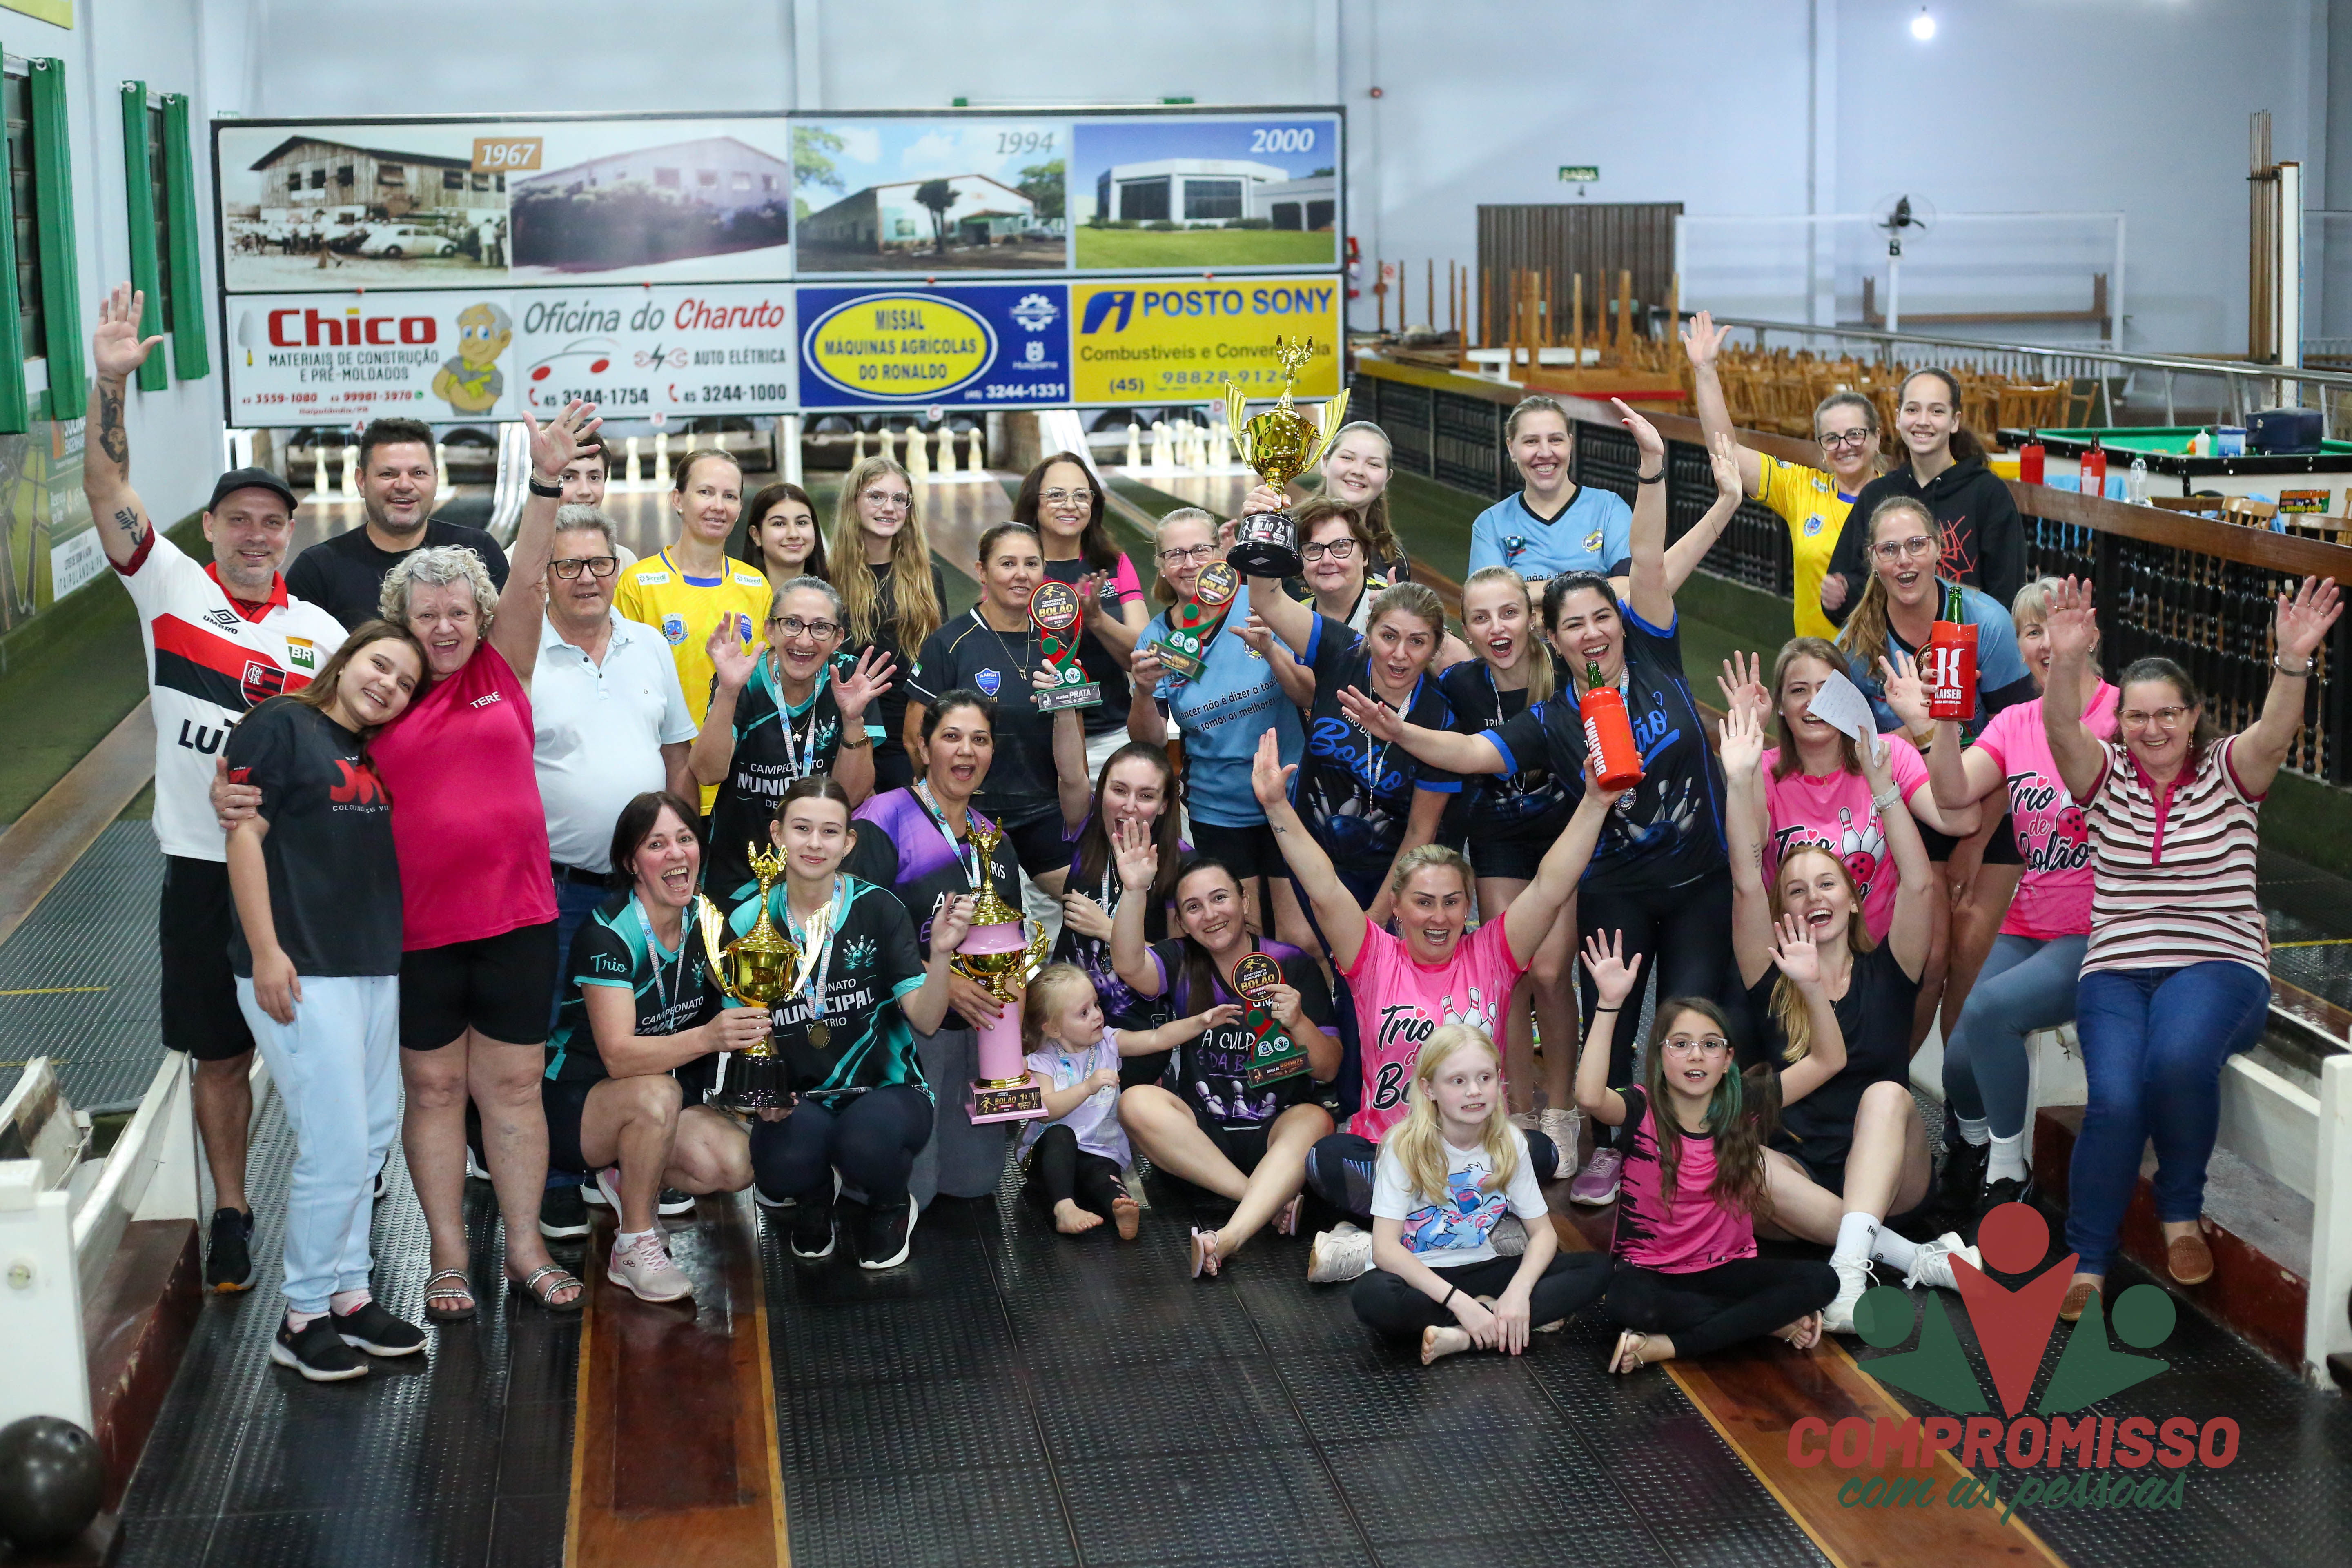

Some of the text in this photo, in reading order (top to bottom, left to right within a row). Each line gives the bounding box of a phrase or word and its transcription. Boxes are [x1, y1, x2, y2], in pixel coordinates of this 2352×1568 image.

[996, 132, 1054, 154] 1994
[1250, 128, 1315, 153] 2000
[481, 143, 536, 167] 1967
[1143, 287, 1333, 317] POSTO SONY
[524, 298, 785, 334] Oficina do Charuto
[875, 309, 925, 330] MISSAL
[268, 307, 437, 347] Chico
[824, 334, 977, 356] MÁQUINAS AGRÍCOLAS
[1202, 348, 1210, 359] e
[268, 348, 438, 367] MATERIAIS DE CONSTRUÇÃO
[694, 347, 786, 365] AUTO ELÉTRICA
[300, 366, 409, 382] E PRÉ-MOLDADOS
[859, 363, 947, 380] DO RONALDO
[702, 384, 787, 402] 3244-1000
[986, 383, 1065, 399] 3244-1331
[1109, 378, 1144, 394] (45)
[563, 387, 648, 406] 3244-1754
[929, 405, 938, 419] C
[1251, 520, 1285, 533] BOLÃO 2º
[646, 573, 666, 581] Sicredi
[1526, 573, 1544, 582] não
[1038, 604, 1074, 618] BOLÃO
[203, 615, 238, 634] UMBRO
[290, 647, 312, 662] BR
[1935, 647, 1965, 688] K
[470, 691, 501, 709] TERE
[1069, 688, 1091, 699] PRATA
[1203, 699, 1220, 713] não
[1221, 694, 1227, 706] é
[1228, 688, 1251, 703] dizer
[1252, 686, 1259, 695] a
[1934, 688, 1962, 699] KAISER
[1201, 715, 1227, 731] somos
[1228, 711, 1238, 721] os
[1309, 717, 1402, 791] Bolão
[1584, 716, 1607, 778] BRAHMA
[751, 759, 824, 775] CAMPEONTO
[2007, 771, 2058, 815] Trio
[765, 799, 779, 809] DE
[2029, 811, 2050, 837] de
[990, 860, 1006, 880] RIS
[590, 953, 627, 973] Trio
[822, 947, 832, 966] MISSAL
[1240, 973, 1275, 991] BOLÃO
[1243, 968, 1267, 978] CAMPEONATO
[771, 987, 875, 1027] MUNCIPAL
[1378, 1004, 1435, 1051] Trio
[1201, 1029, 1256, 1051] A CULP
[1208, 1051, 1228, 1070] DA
[994, 1094, 1017, 1105] BOLÃO
[1020, 1093, 1028, 1102] 1º
